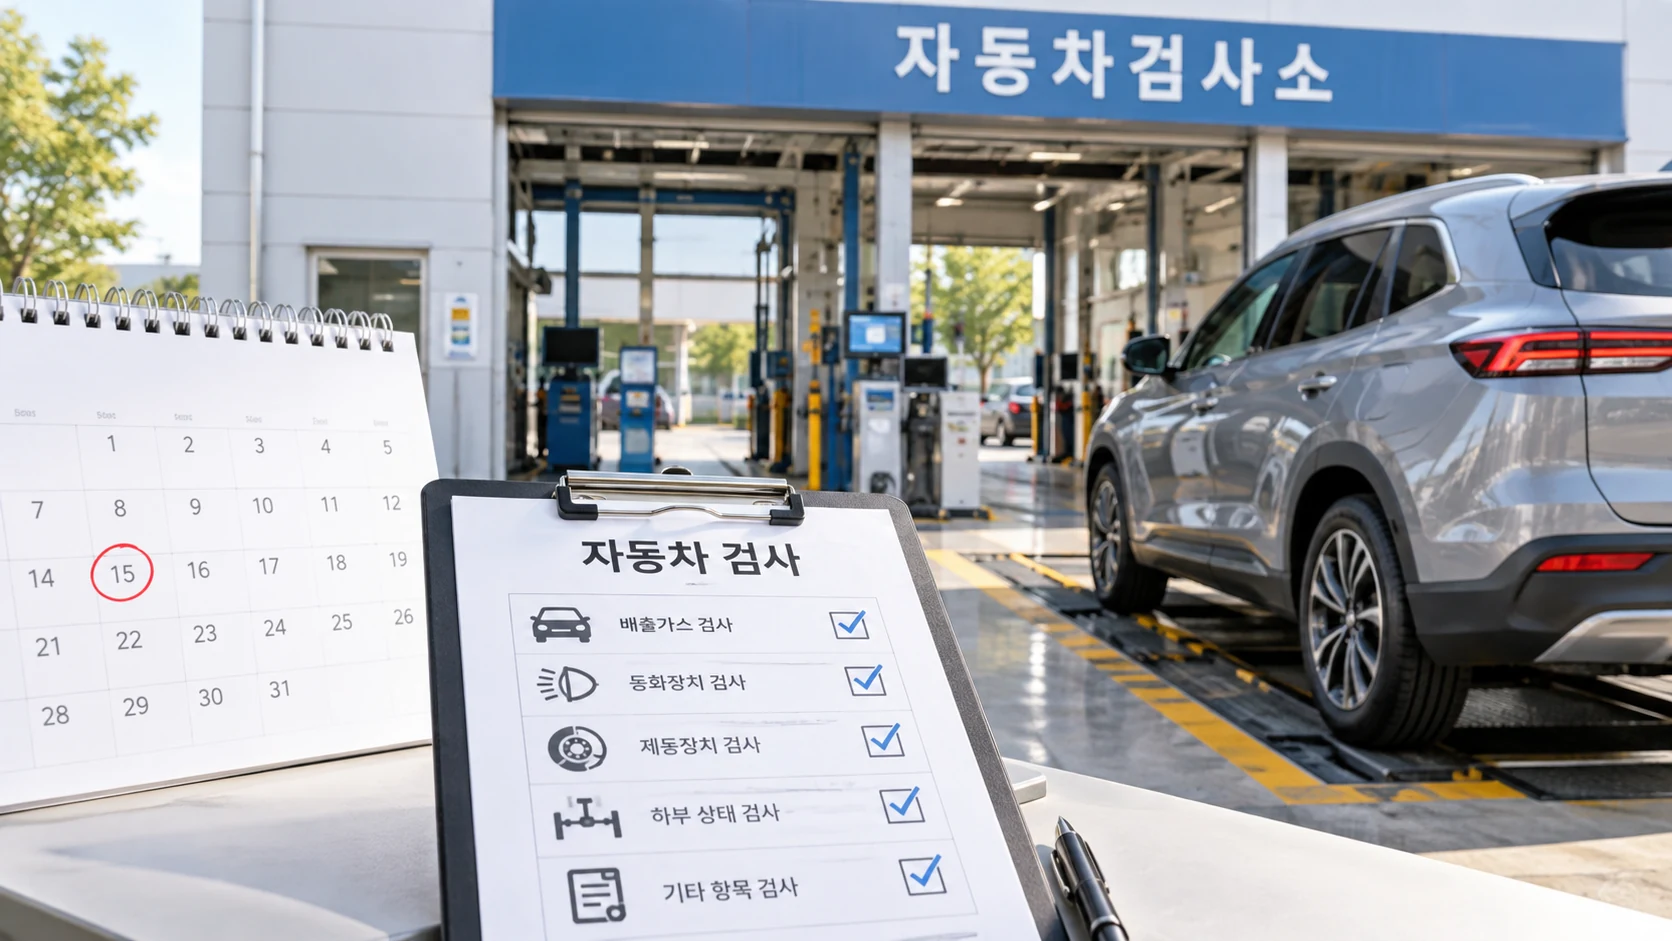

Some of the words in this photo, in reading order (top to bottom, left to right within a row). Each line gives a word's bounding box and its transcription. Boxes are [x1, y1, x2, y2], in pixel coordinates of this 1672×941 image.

[894, 22, 1333, 106] 자동차검사소
[107, 434, 116, 452] 1
[183, 435, 195, 454] 2
[254, 437, 265, 454] 3
[320, 438, 332, 455] 4
[383, 439, 393, 455] 5
[31, 500, 44, 520] 7
[113, 498, 127, 518] 8
[189, 497, 202, 516] 9
[252, 496, 274, 515] 10
[320, 496, 338, 513] 11
[382, 494, 402, 512] 12
[28, 568, 55, 589] 14
[110, 564, 136, 584] 15
[187, 560, 211, 580] 16
[258, 557, 280, 576] 17
[326, 554, 348, 572] 18
[389, 550, 409, 569] 19
[580, 538, 710, 576] 자동차
[721, 541, 802, 577] 검사
[35, 636, 61, 658] 21
[116, 630, 143, 651] 22
[193, 623, 218, 644] 23
[263, 618, 287, 637] 24
[331, 613, 353, 632] 25
[393, 608, 414, 626] 26
[619, 616, 694, 634] 배출가스
[697, 616, 734, 634] 검사
[628, 674, 705, 693] 동화장치
[709, 674, 747, 692] 검사
[41, 704, 70, 727] 28
[122, 695, 149, 717] 29
[198, 687, 224, 707] 30
[268, 679, 291, 699] 31
[639, 736, 719, 756] 제동장치
[722, 735, 762, 755] 검사
[650, 806, 692, 827] 하부
[696, 804, 737, 826] 상태
[741, 802, 781, 823] 검사
[662, 881, 706, 904] 기타
[709, 879, 753, 902] 항목
[757, 876, 799, 899] 검사
